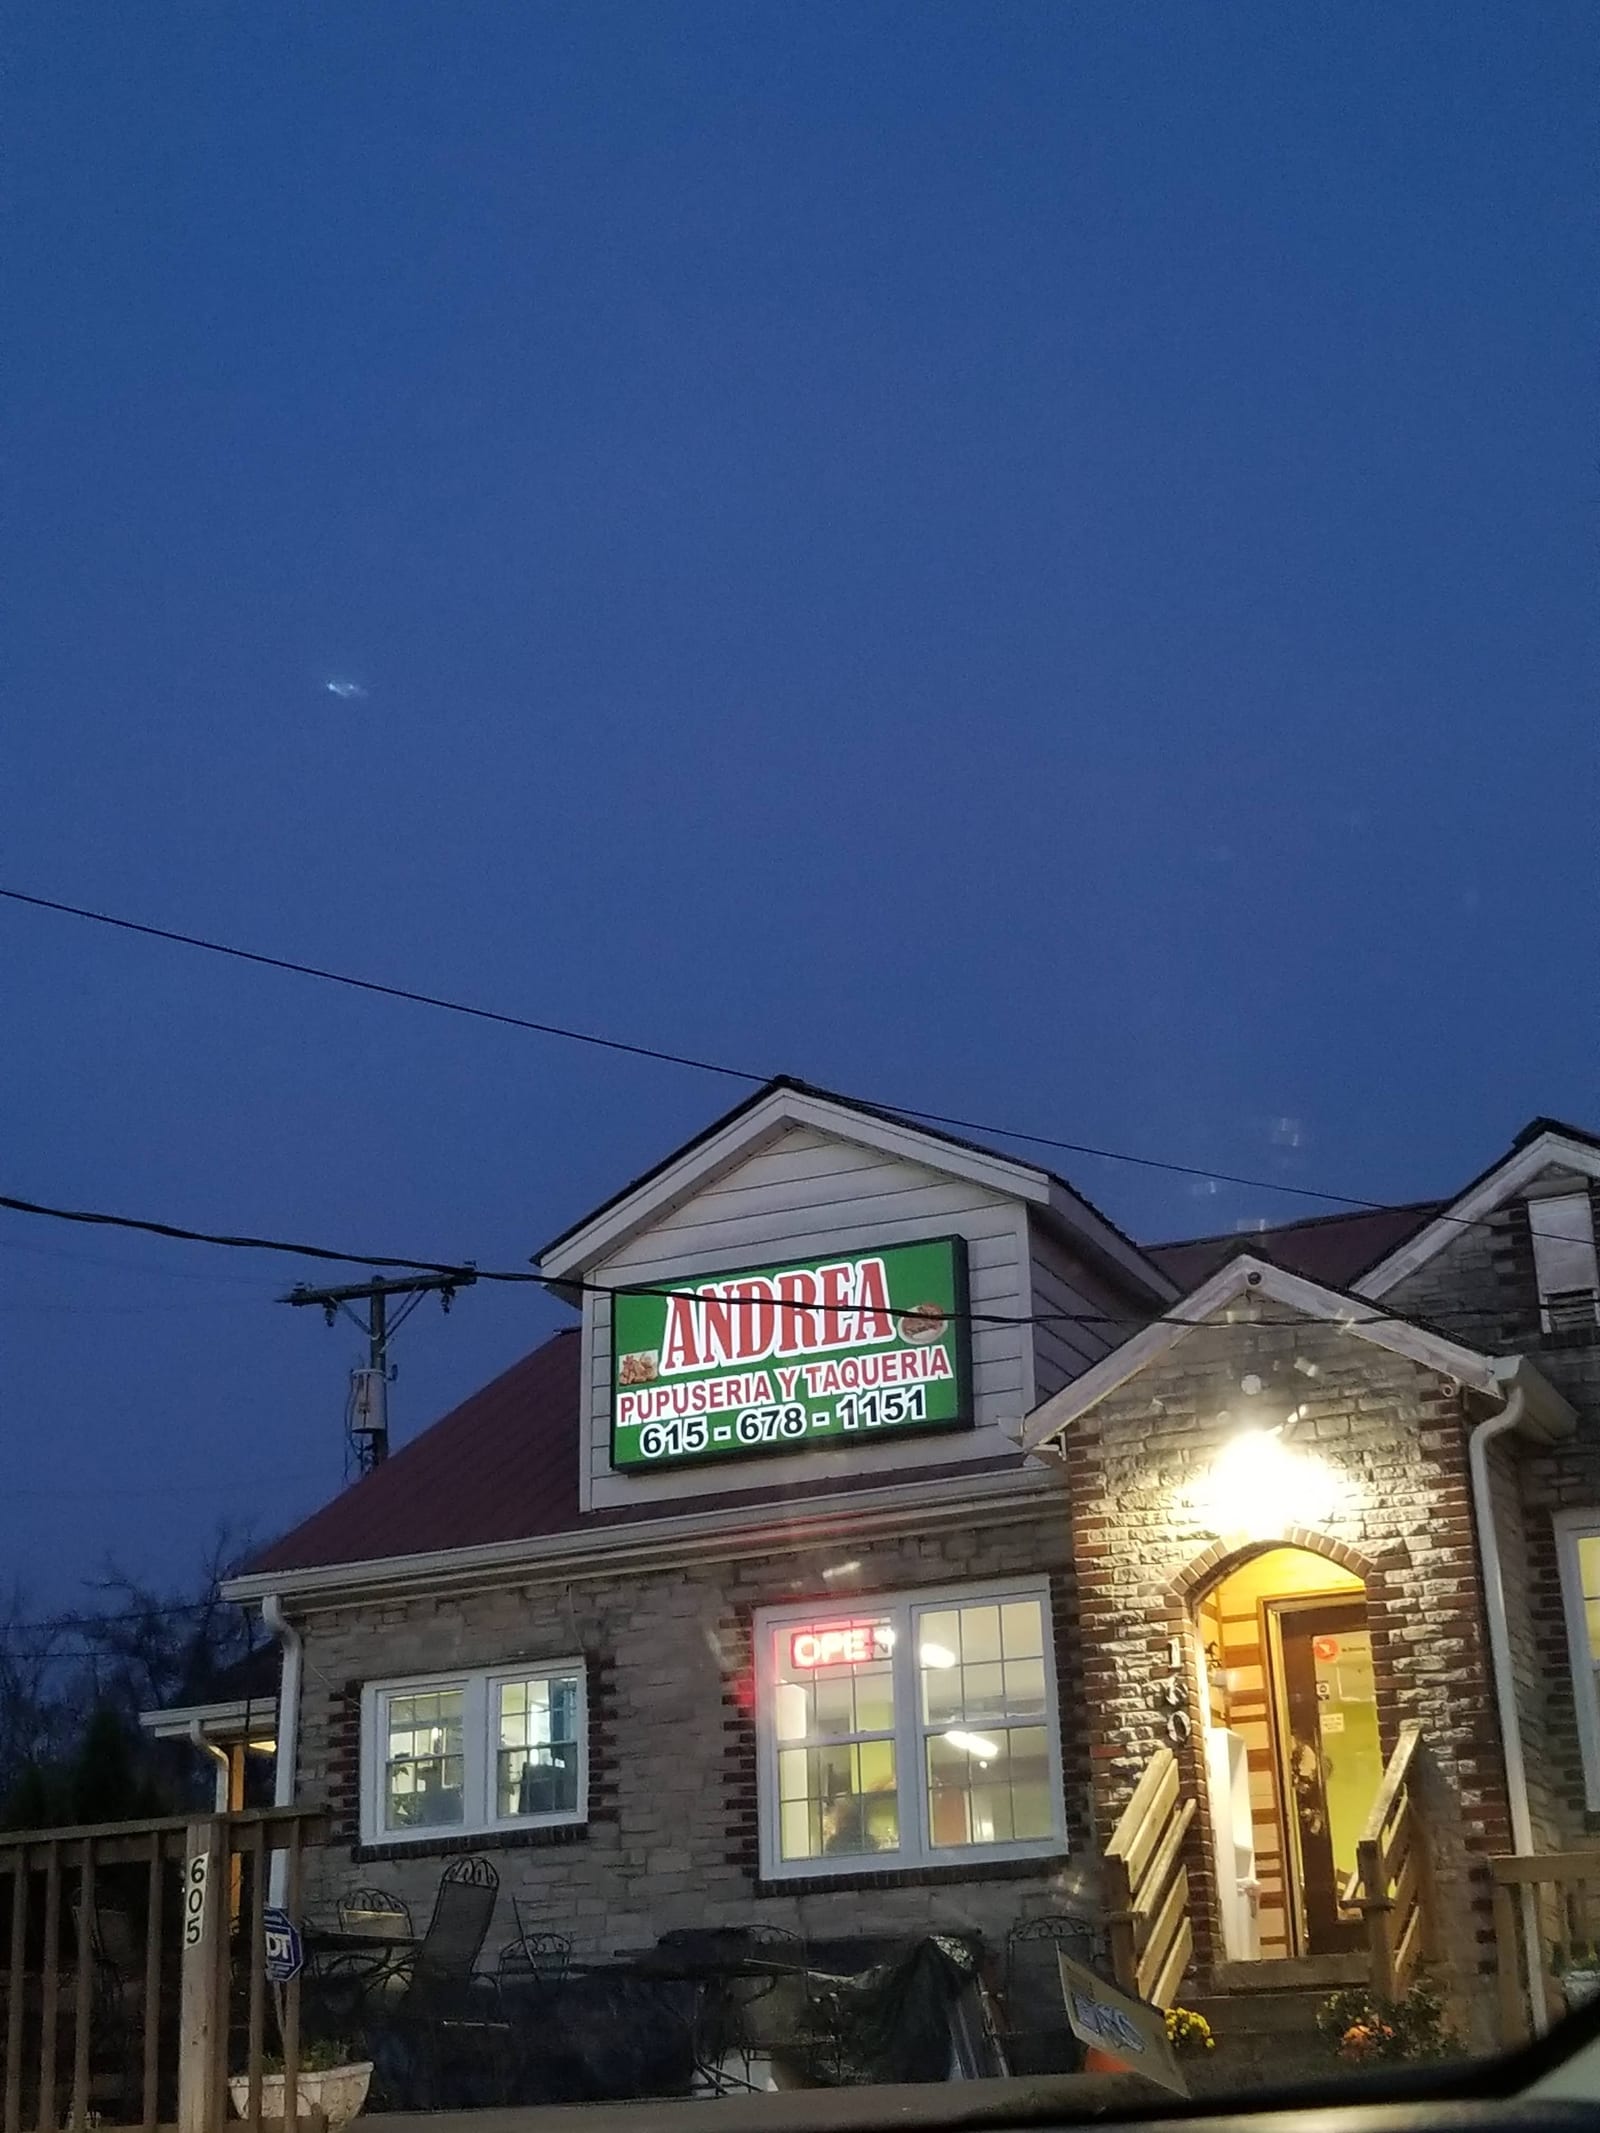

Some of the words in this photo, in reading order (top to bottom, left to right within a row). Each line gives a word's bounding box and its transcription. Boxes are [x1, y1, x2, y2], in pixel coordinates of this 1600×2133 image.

[664, 1261, 893, 1370] ANDREA
[620, 1376, 770, 1423] PUPUSERIA
[780, 1369, 798, 1397] Y
[807, 1347, 949, 1394] TAQUERIA
[186, 1857, 205, 1945] 605
[265, 1931, 291, 1960] DT
